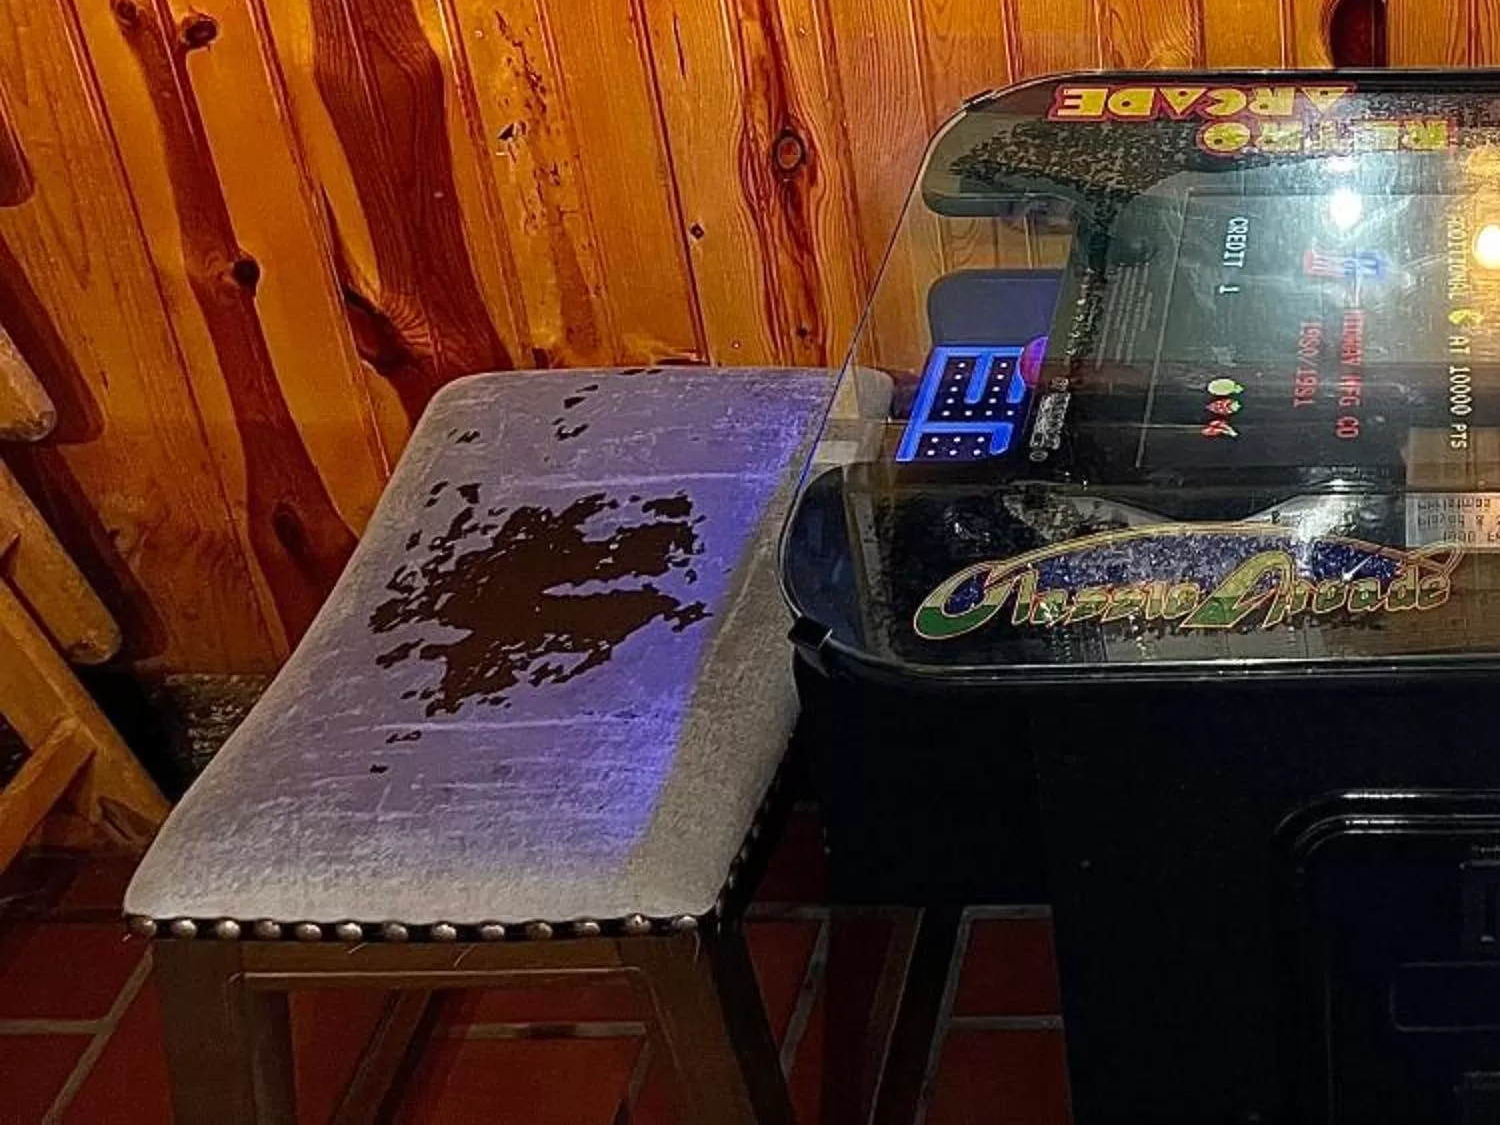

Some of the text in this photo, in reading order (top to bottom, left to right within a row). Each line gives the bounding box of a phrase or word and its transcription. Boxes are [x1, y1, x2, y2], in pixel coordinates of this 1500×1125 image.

[1055, 84, 1352, 118] ARCADE
[1200, 120, 1450, 153] RETRO
[1219, 216, 1248, 295] CREDIT 1
[1448, 335, 1471, 356] AT
[1449, 365, 1473, 417] 10000
[1450, 423, 1468, 450] PTS
